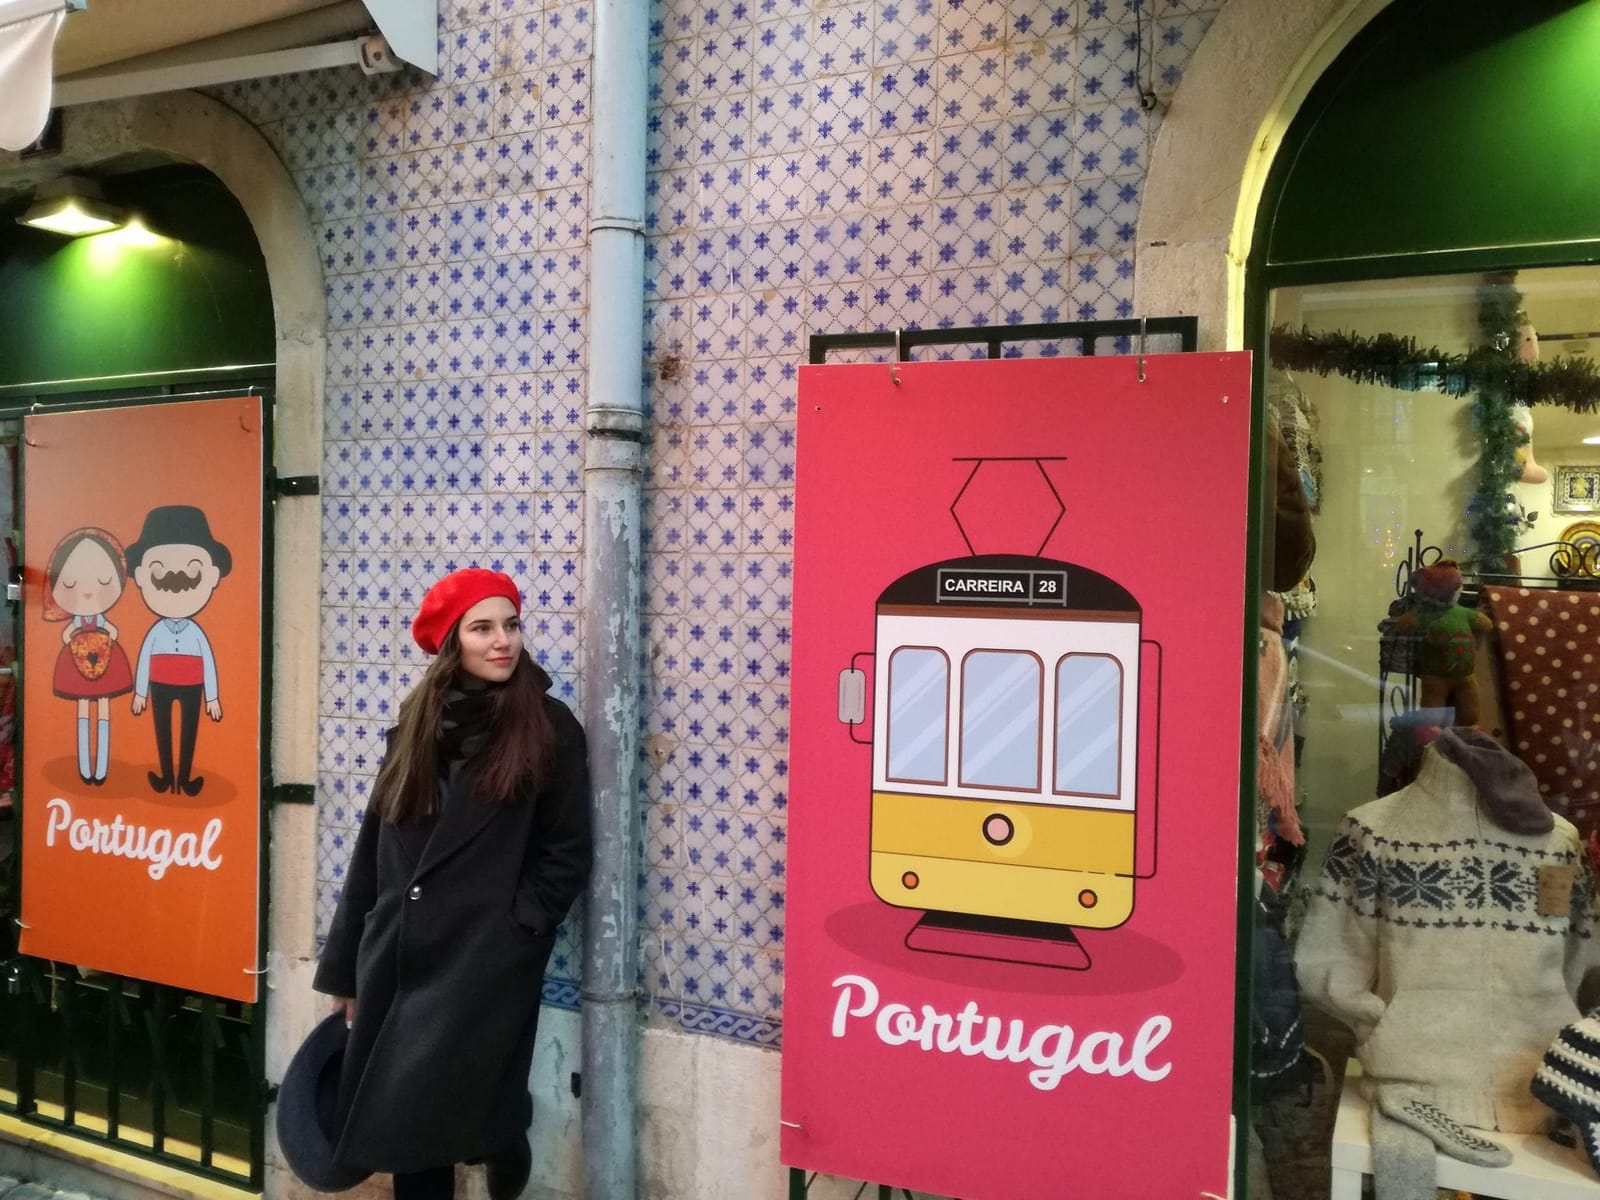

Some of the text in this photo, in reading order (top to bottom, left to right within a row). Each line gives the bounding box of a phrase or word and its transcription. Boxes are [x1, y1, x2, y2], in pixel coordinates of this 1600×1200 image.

[944, 578, 1057, 593] CARREIRA 28
[46, 798, 223, 880] Portugal
[831, 974, 1172, 1091] Portugal
